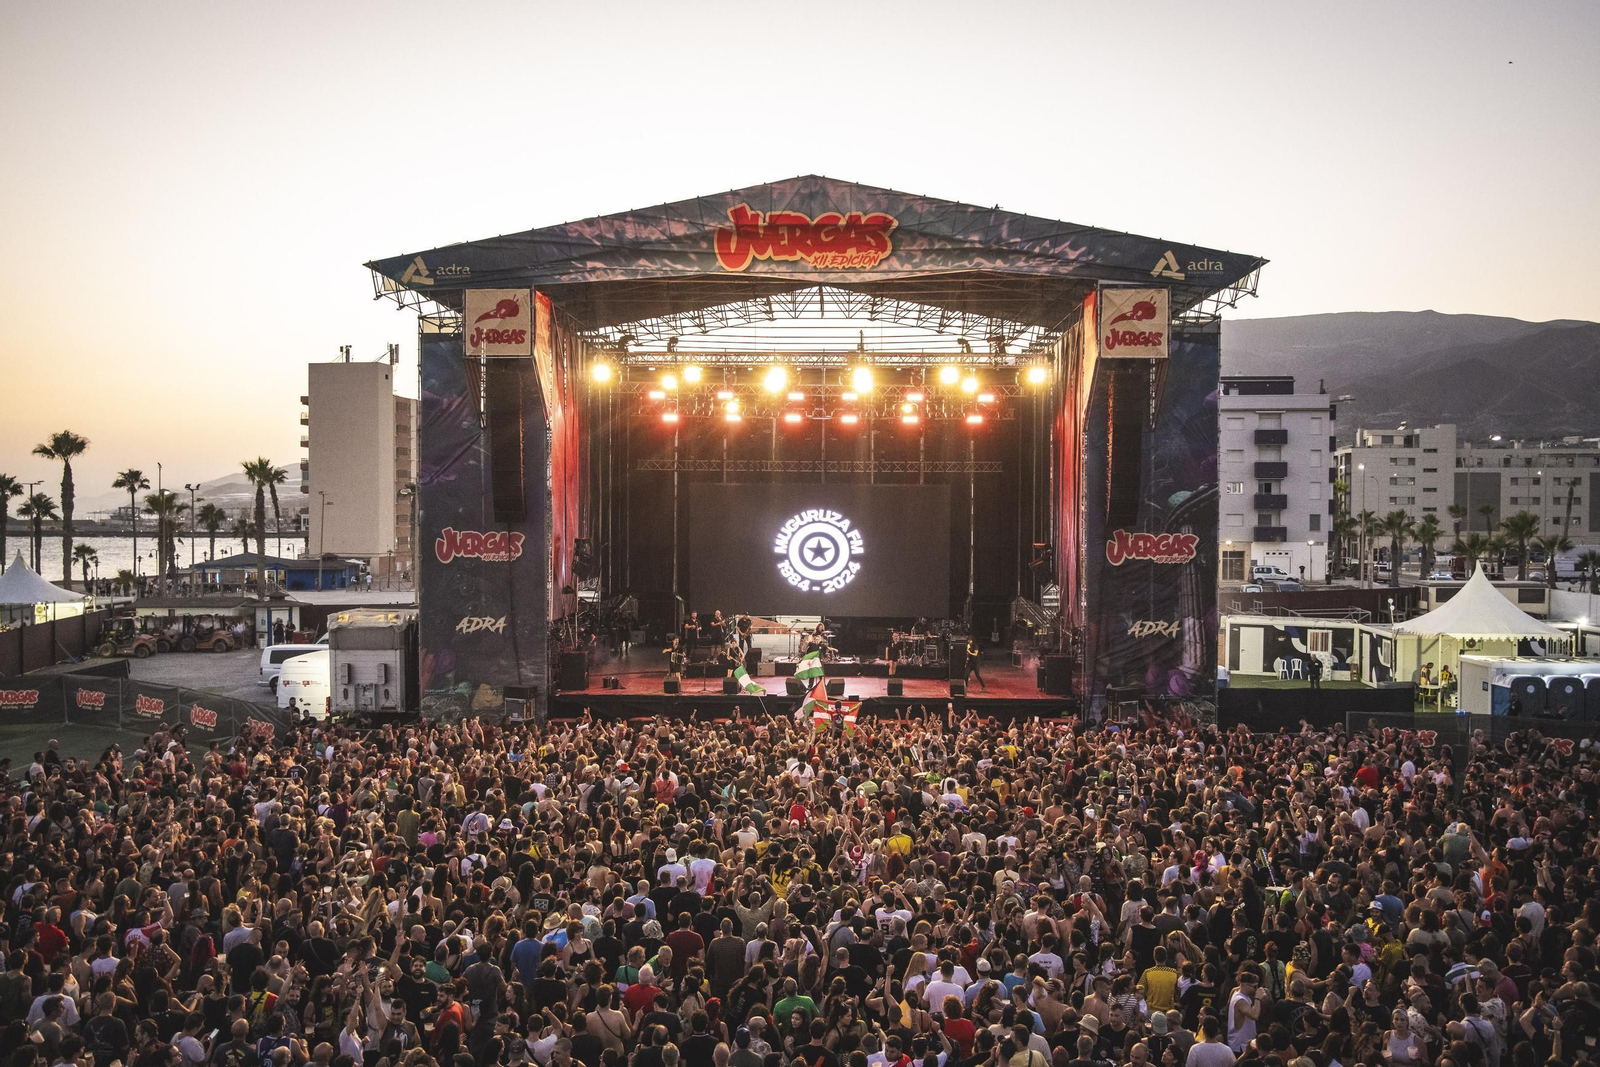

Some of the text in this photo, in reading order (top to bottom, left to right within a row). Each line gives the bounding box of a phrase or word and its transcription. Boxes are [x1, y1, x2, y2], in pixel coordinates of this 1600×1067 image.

[714, 203, 899, 271] JUERGAS
[812, 250, 880, 267] XII EDICIÓN
[1187, 258, 1224, 271] adra
[436, 264, 471, 275] adra
[1104, 327, 1164, 350] JUERGAS
[774, 509, 864, 554] MUGURUZA FM
[435, 526, 525, 564] JUERGAS
[1106, 528, 1199, 566] JUERGAS
[777, 559, 811, 591] 1984
[822, 561, 861, 593] 2024
[455, 615, 507, 635] ADRA
[1127, 619, 1181, 638] ADRA
[0, 689, 39, 706] UERGAS
